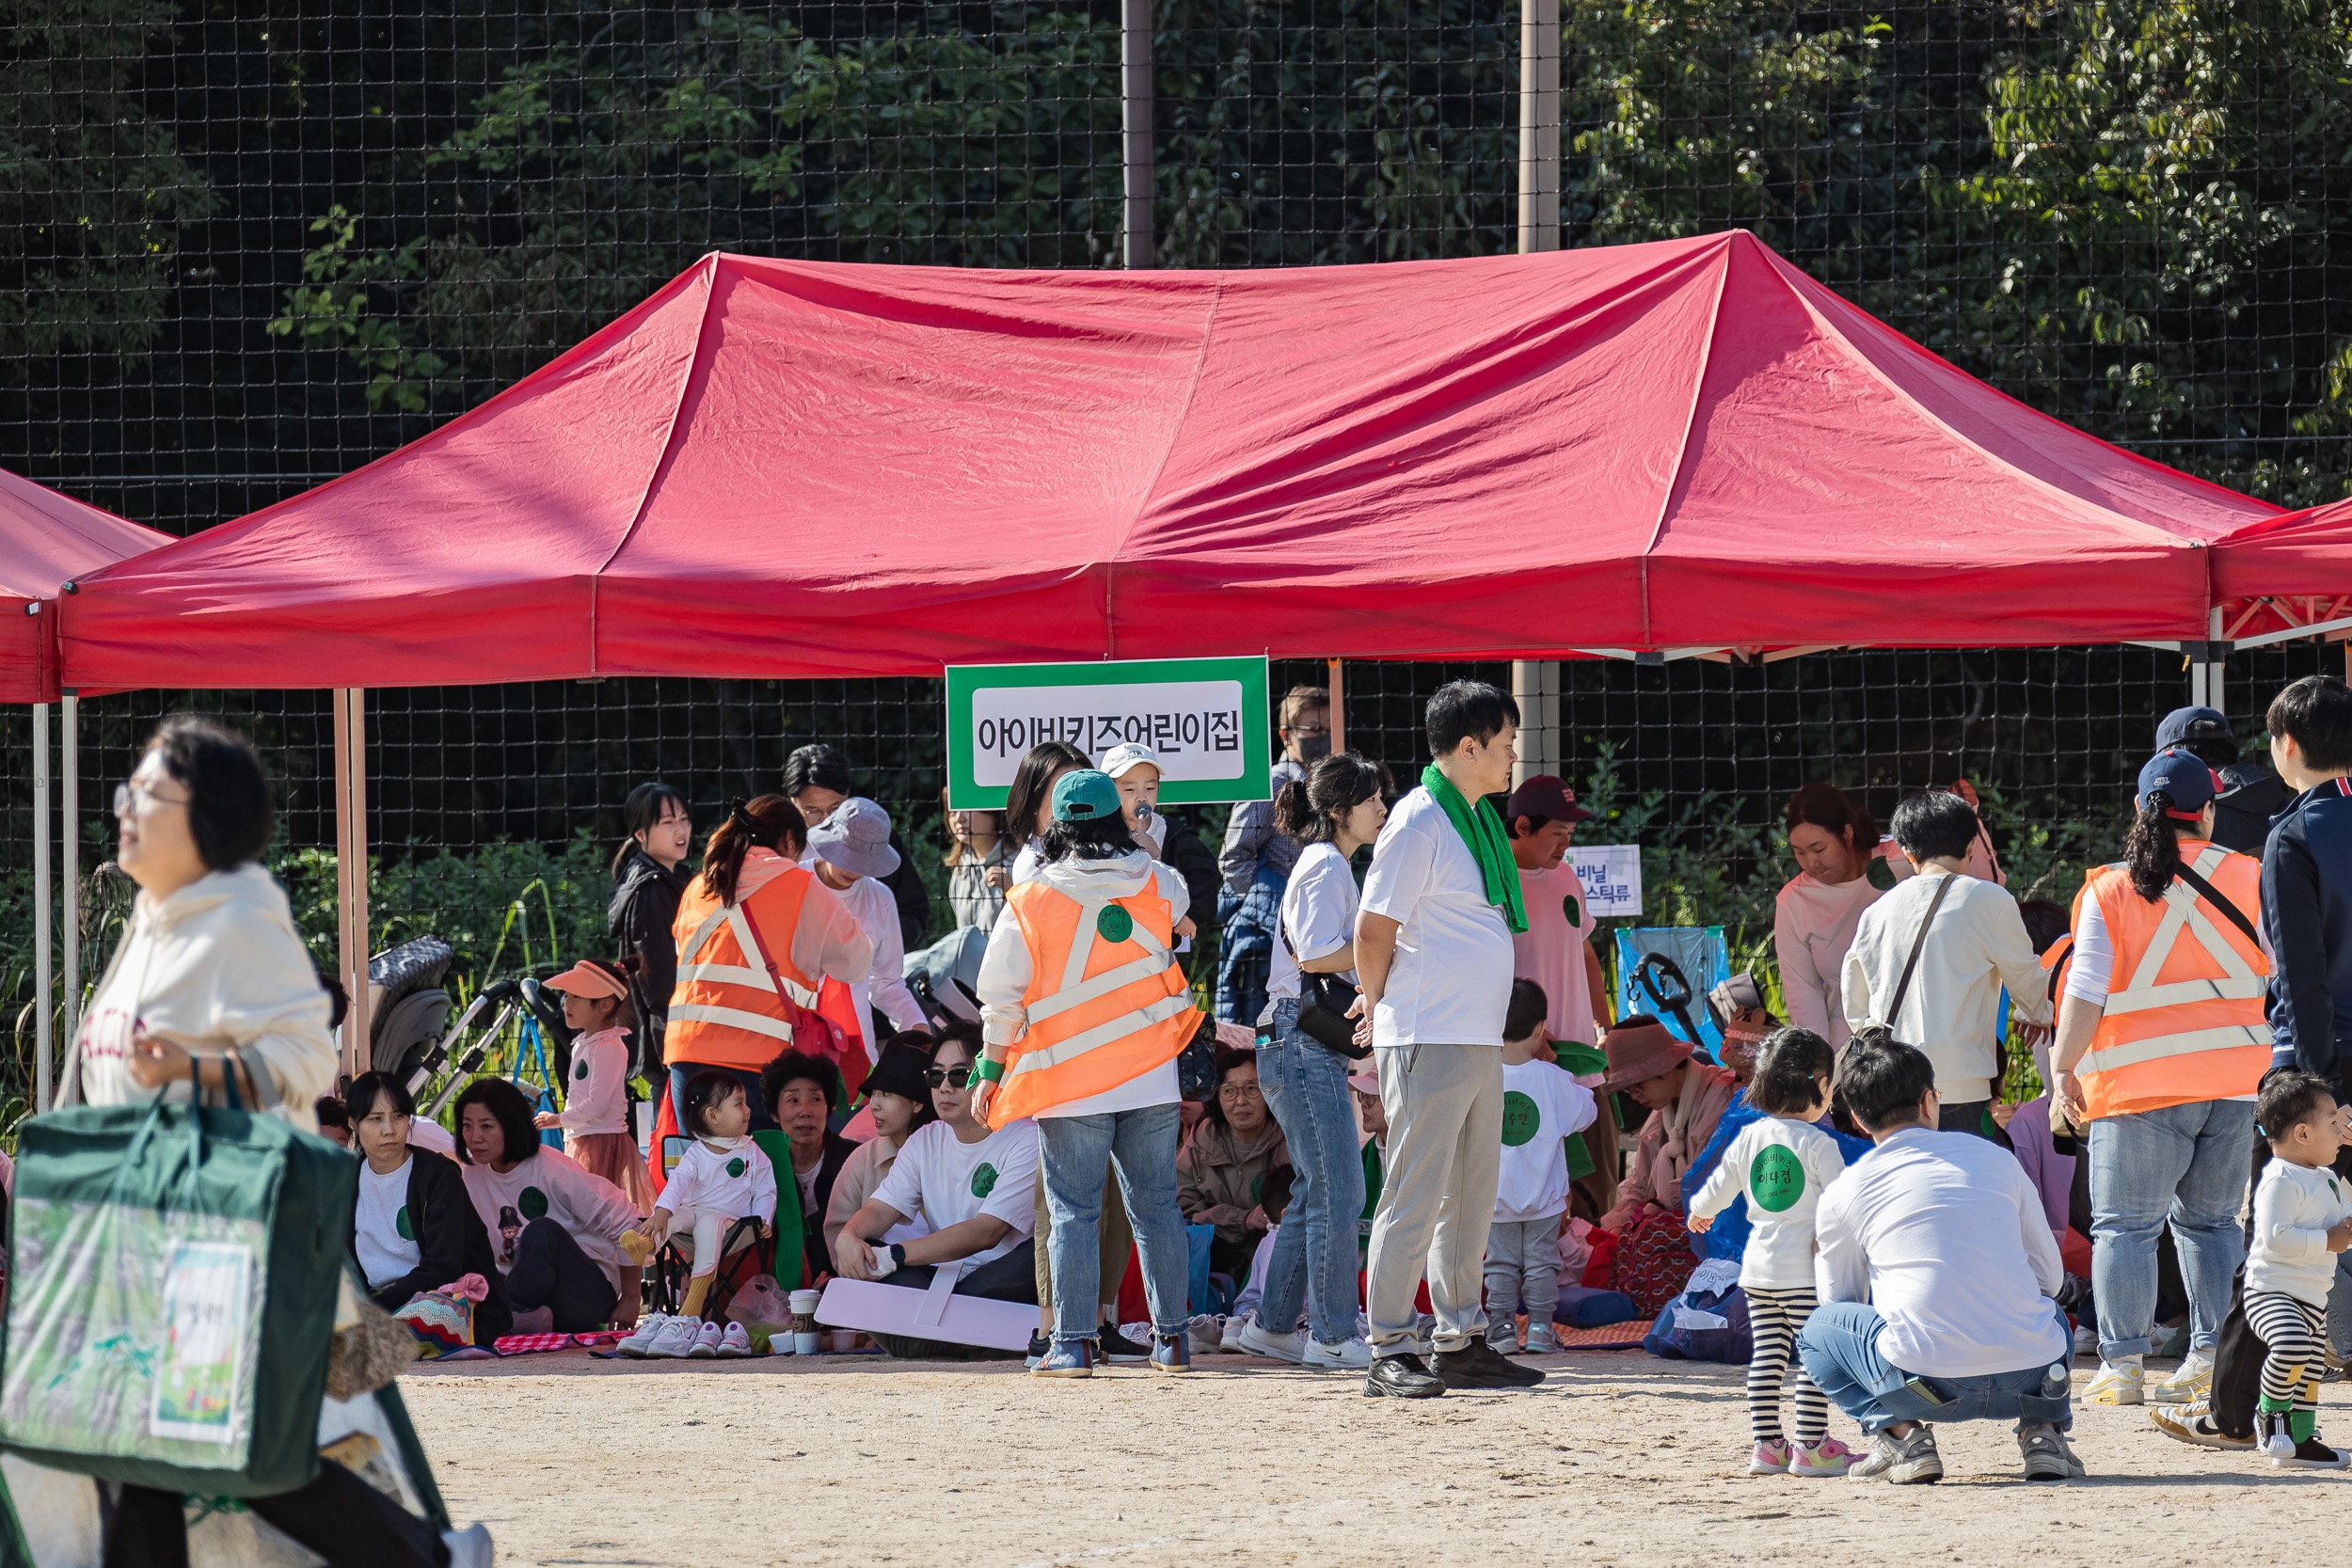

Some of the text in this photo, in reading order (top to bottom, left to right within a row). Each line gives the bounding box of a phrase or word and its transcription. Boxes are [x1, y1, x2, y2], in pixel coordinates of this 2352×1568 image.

[978, 710, 1239, 758] 아이비키즈어린이집
[1577, 863, 1606, 883] 비닐
[1585, 885, 1631, 904] 스틱류
[1100, 908, 1126, 925] 아이비키즈
[1504, 1098, 1532, 1114] 비키즈
[1756, 1152, 1792, 1173] 아이비키즈
[1757, 1169, 1791, 1185] 이다겸
